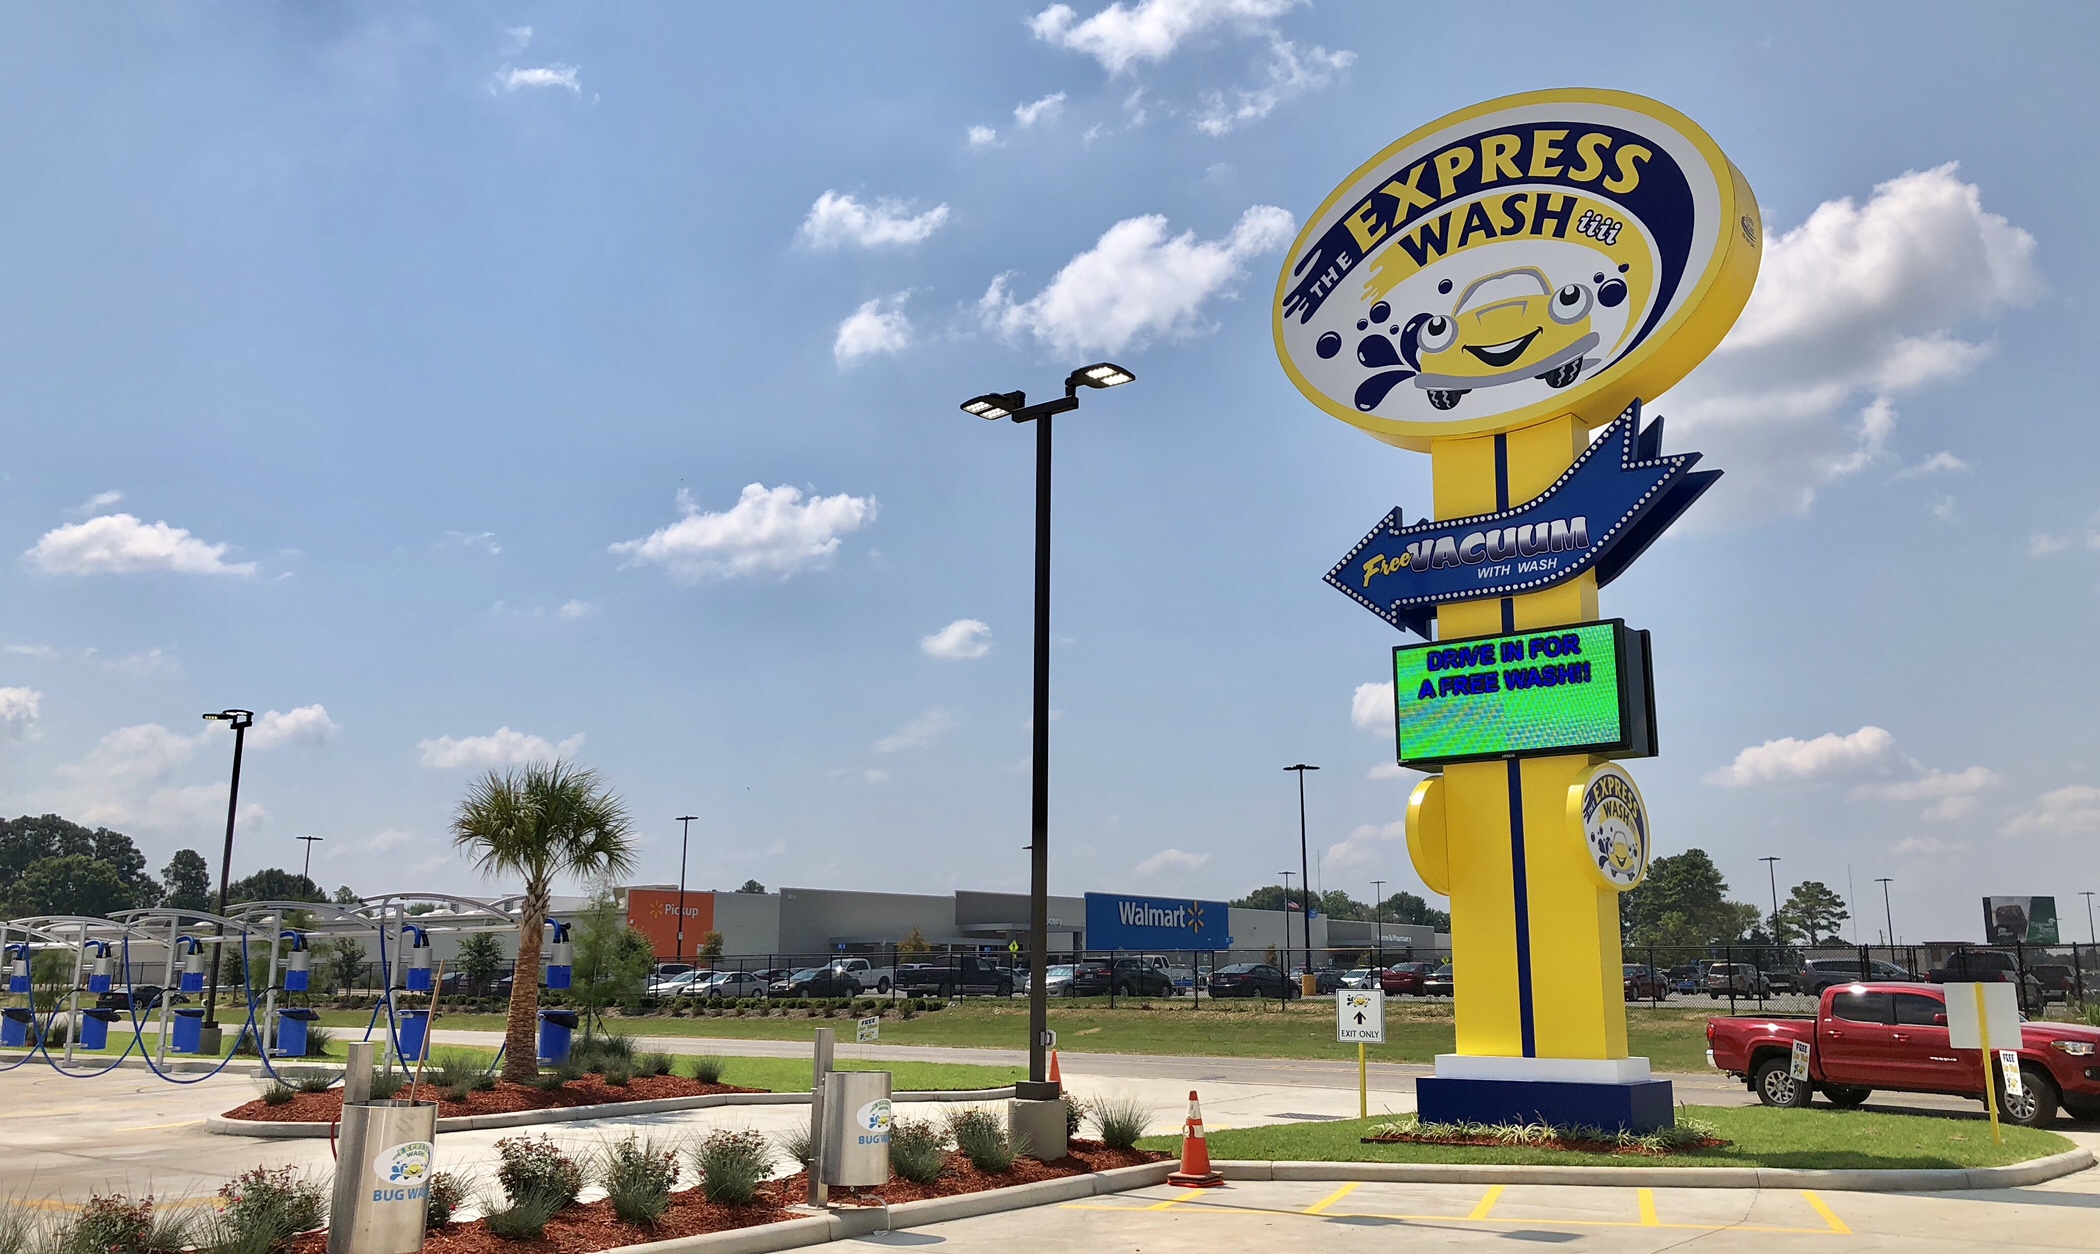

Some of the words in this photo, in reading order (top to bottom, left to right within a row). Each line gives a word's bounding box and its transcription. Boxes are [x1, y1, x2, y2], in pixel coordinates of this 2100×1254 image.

[1310, 251, 1353, 298] THE
[1343, 130, 1653, 254] EXPRESS
[1397, 193, 1579, 268] WASH
[1361, 551, 1414, 588] Free
[1406, 516, 1591, 573] VACUUM
[1477, 564, 1511, 580] WITH
[1517, 557, 1559, 574] WASH
[1427, 643, 1496, 672] DRIVE
[1501, 640, 1525, 663] IN
[1528, 632, 1582, 660] FOR
[1417, 678, 1437, 700] A
[1438, 670, 1500, 698] FREE
[1503, 661, 1592, 691] WASH!!
[1592, 776, 1639, 819] EXPRESS
[1602, 800, 1630, 826] WASH
[664, 903, 699, 919] Pickup
[1118, 900, 1186, 928] Walmart
[1341, 1030, 1357, 1038] EXIT
[1359, 1030, 1380, 1038] ONLY
[1796, 1043, 1808, 1053] FREE
[2002, 1053, 2015, 1063] FREE
[858, 1134, 880, 1145] BUG
[372, 1189, 405, 1202] BUG
